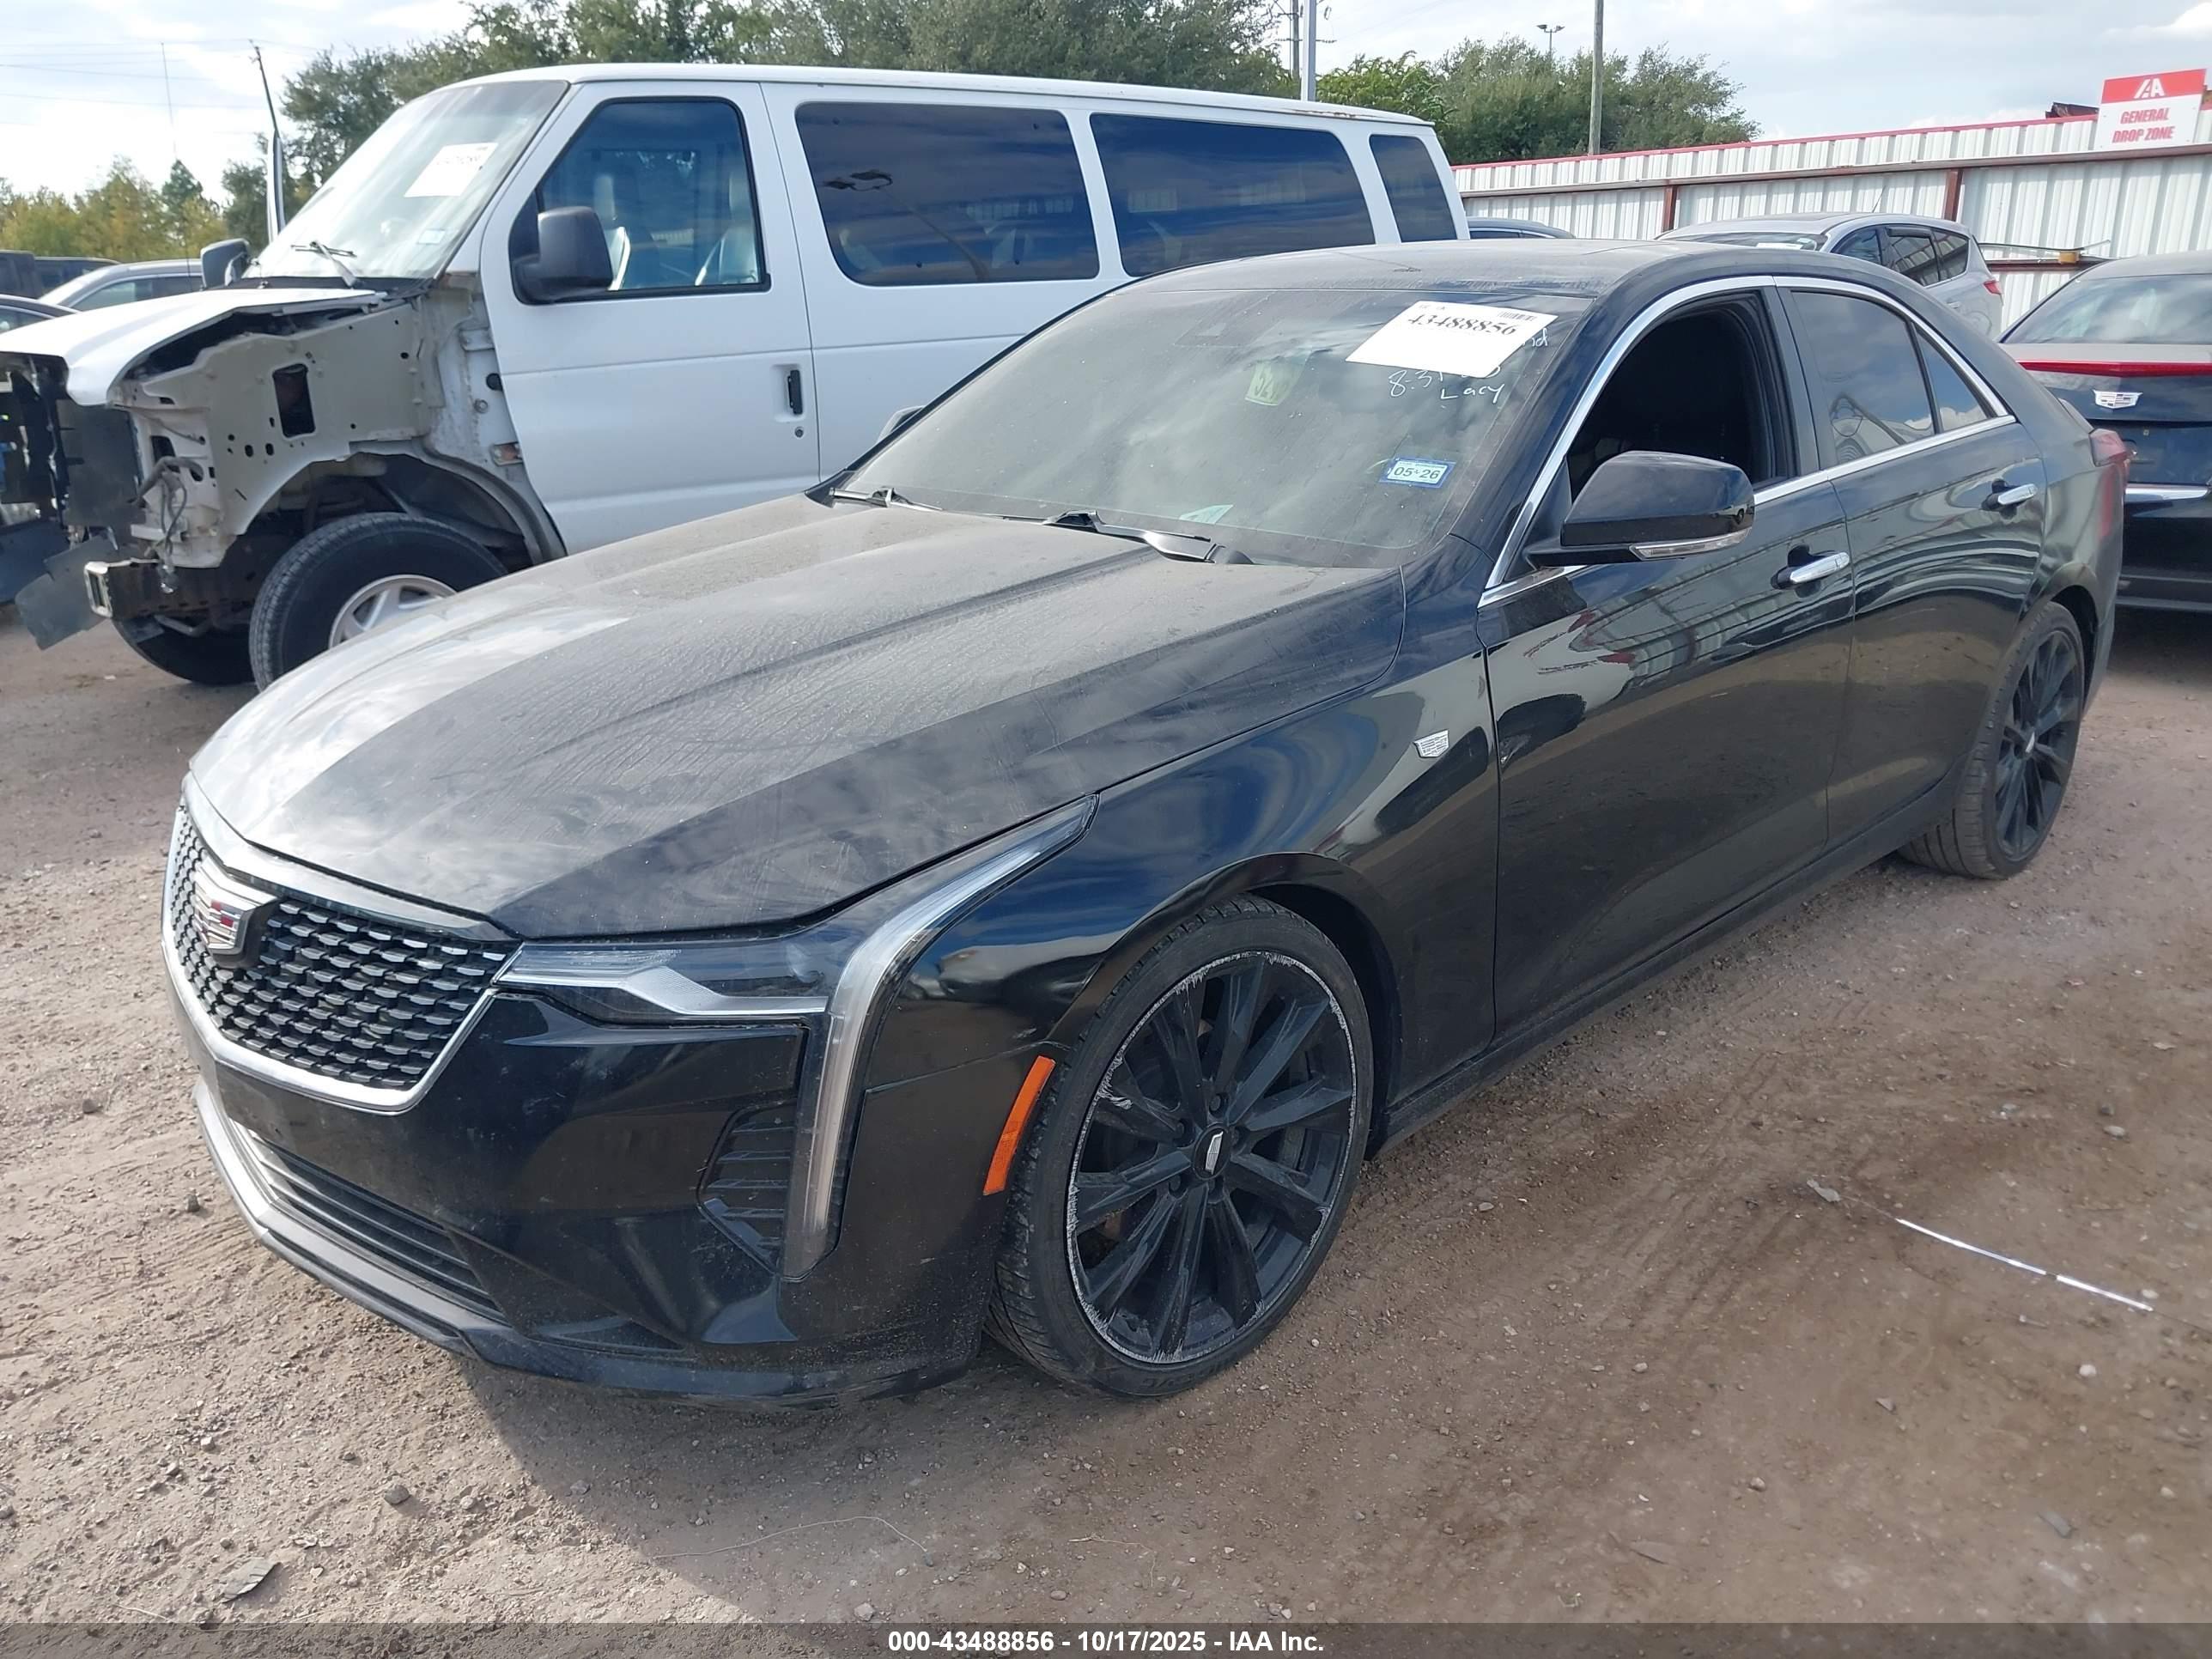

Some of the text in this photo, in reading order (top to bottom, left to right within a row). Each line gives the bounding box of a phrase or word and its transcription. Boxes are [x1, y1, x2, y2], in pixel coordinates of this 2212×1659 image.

[2119, 107, 2170, 125] GENERAL
[2112, 125, 2176, 144] DROP ZONE
[1407, 313, 1518, 336] 43488856
[1440, 383, 1505, 404] Lacy
[1394, 466, 1442, 480] 05 26
